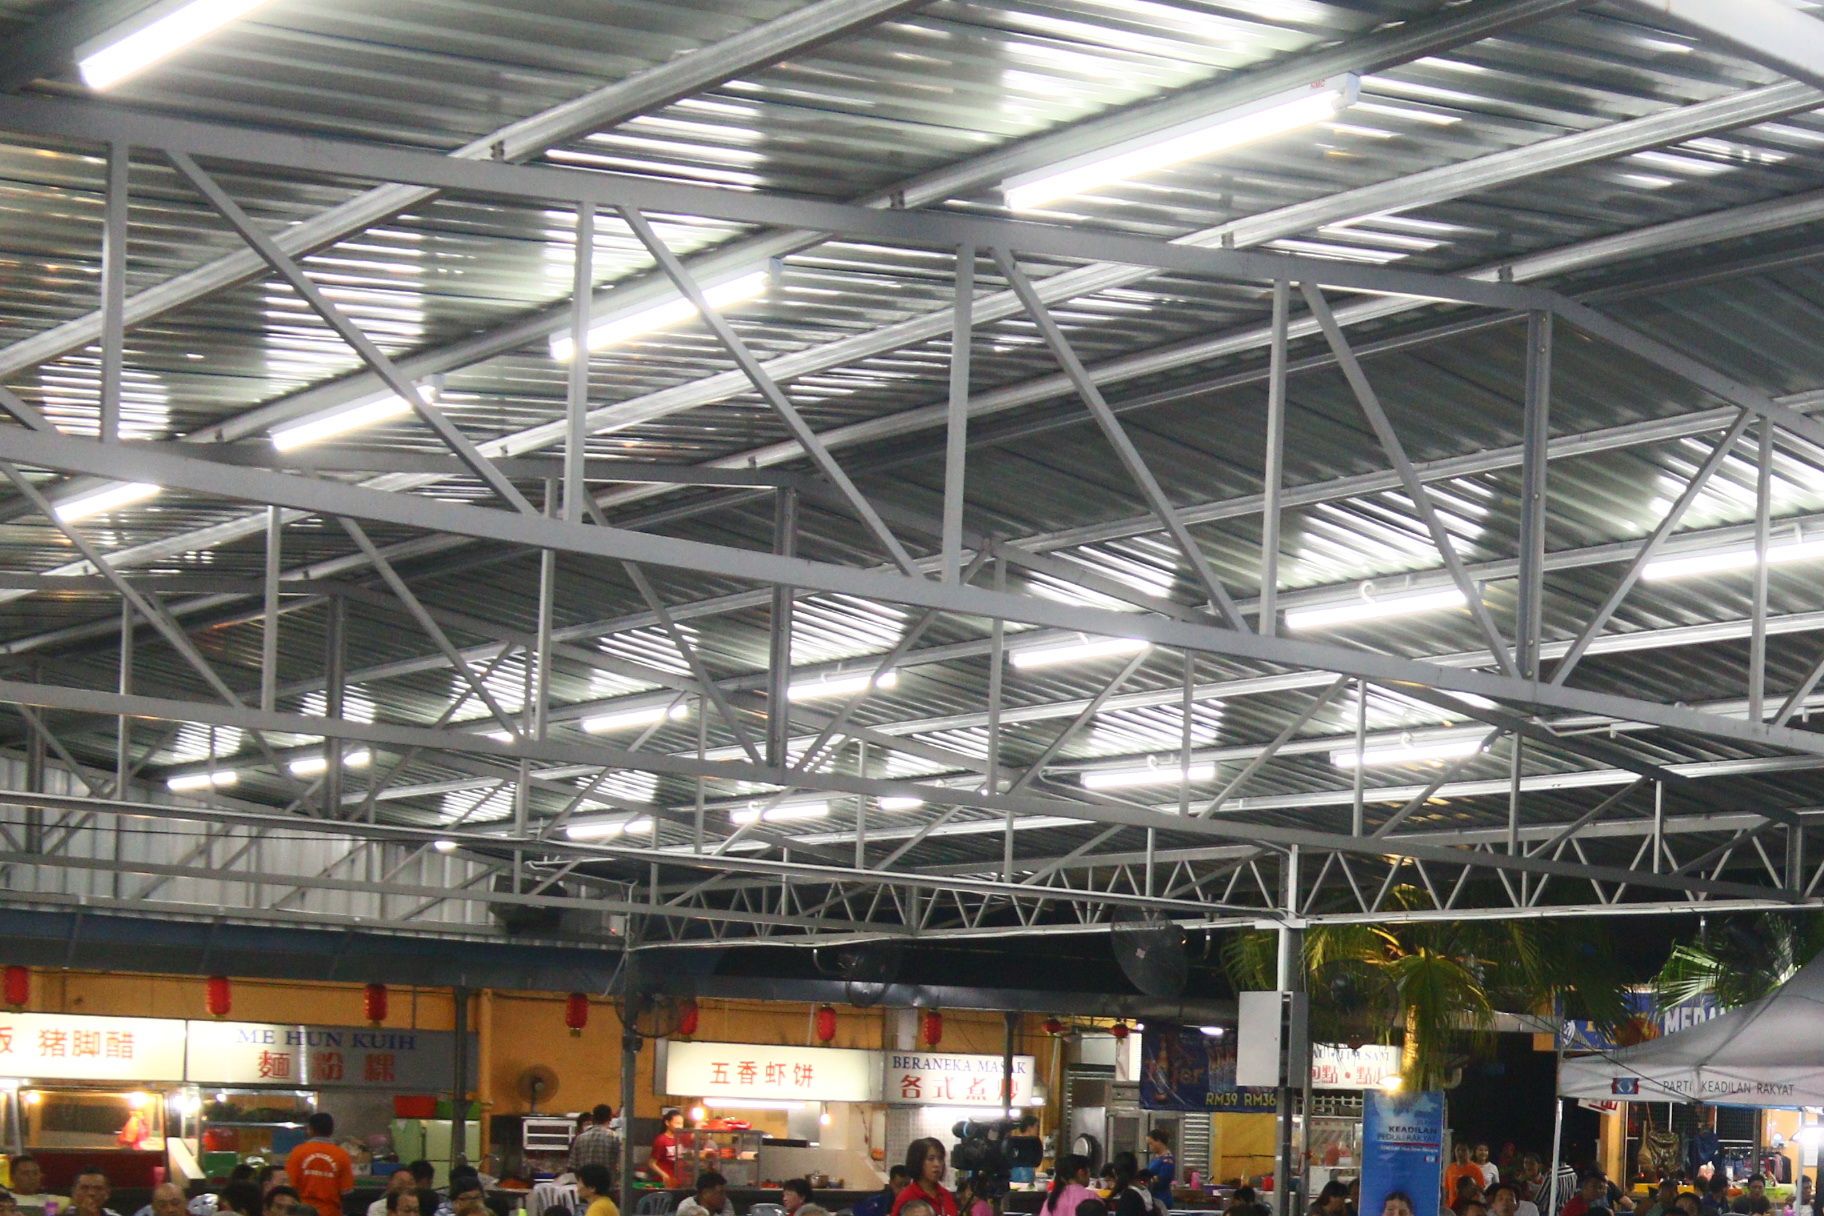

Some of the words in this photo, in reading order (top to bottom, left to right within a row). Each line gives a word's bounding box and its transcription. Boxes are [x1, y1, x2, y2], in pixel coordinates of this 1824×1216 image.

[1663, 1003, 1728, 1037] MEDA
[38, 1028, 135, 1060] 猪脚醋
[237, 1029, 276, 1044] ME
[285, 1031, 343, 1046] HUN
[352, 1032, 418, 1049] KUIH
[893, 1056, 972, 1071] BERANEKA
[709, 1061, 815, 1088] 五香虾饼
[1663, 1080, 1693, 1093] PARTI
[1702, 1081, 1751, 1094] KEADILAN
[1756, 1084, 1795, 1096] RAKYAT
[1205, 1092, 1238, 1106] RM39
[1244, 1093, 1276, 1107] RM36
[1388, 1126, 1437, 1134] KEADILAN
